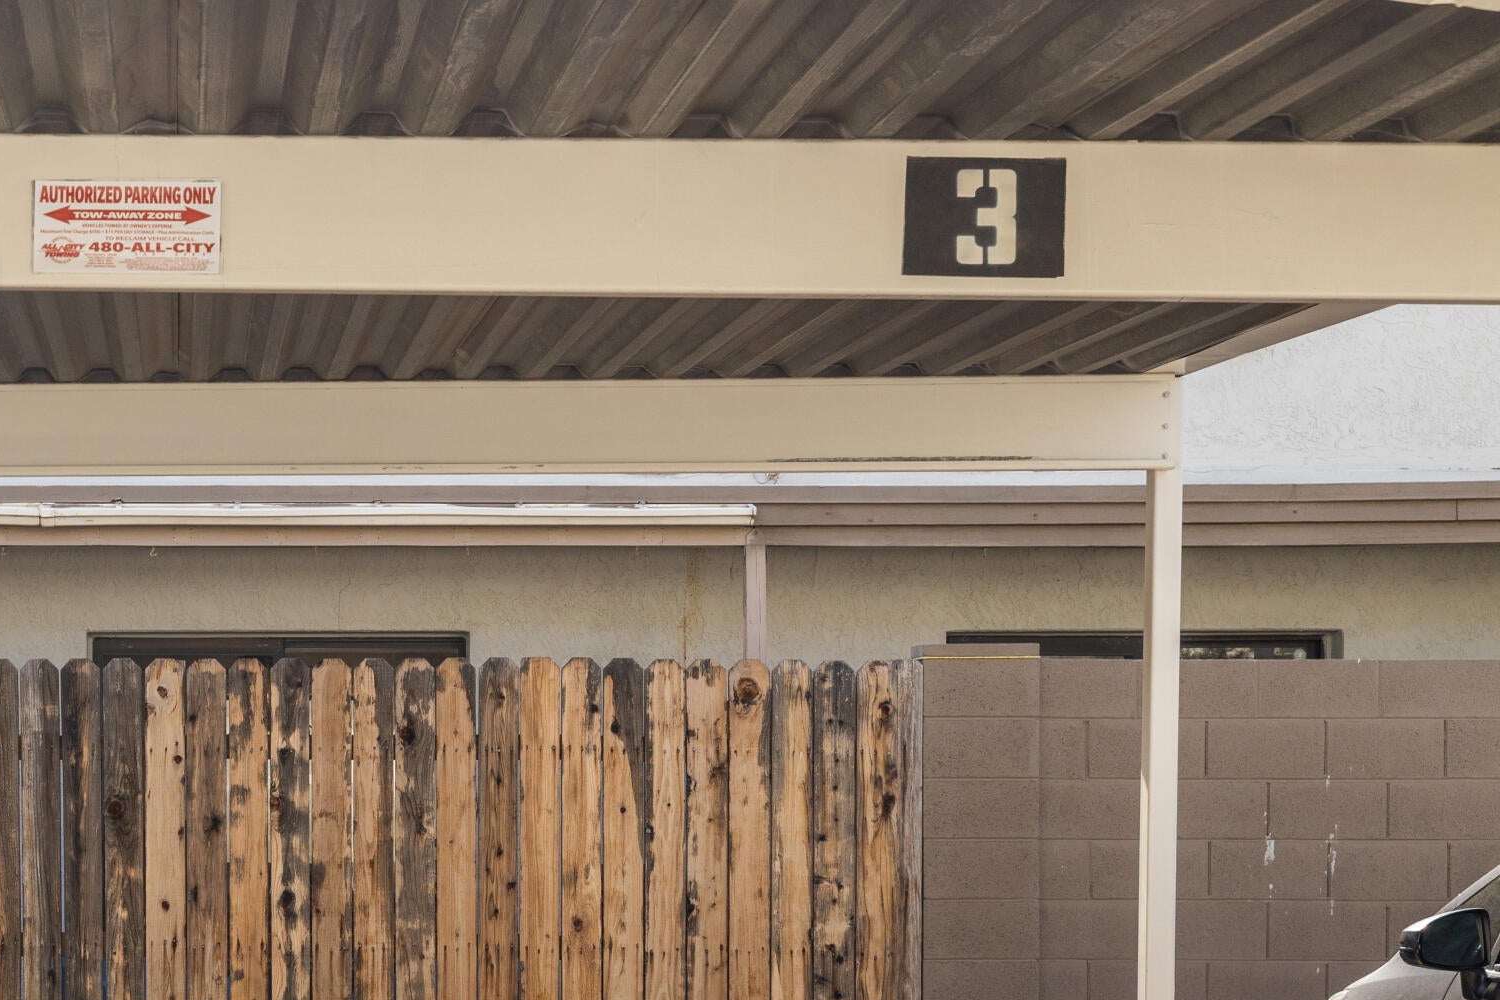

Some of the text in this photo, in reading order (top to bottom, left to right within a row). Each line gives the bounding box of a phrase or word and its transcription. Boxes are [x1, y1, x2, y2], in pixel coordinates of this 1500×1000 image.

[39, 185, 216, 204] AUTHORIZED PARKING ONLY
[73, 211, 182, 220] TOW-AWAY ZONE
[956, 168, 1017, 265] 3
[63, 243, 85, 251] CITY
[88, 242, 216, 253] 480-ALL-CITY
